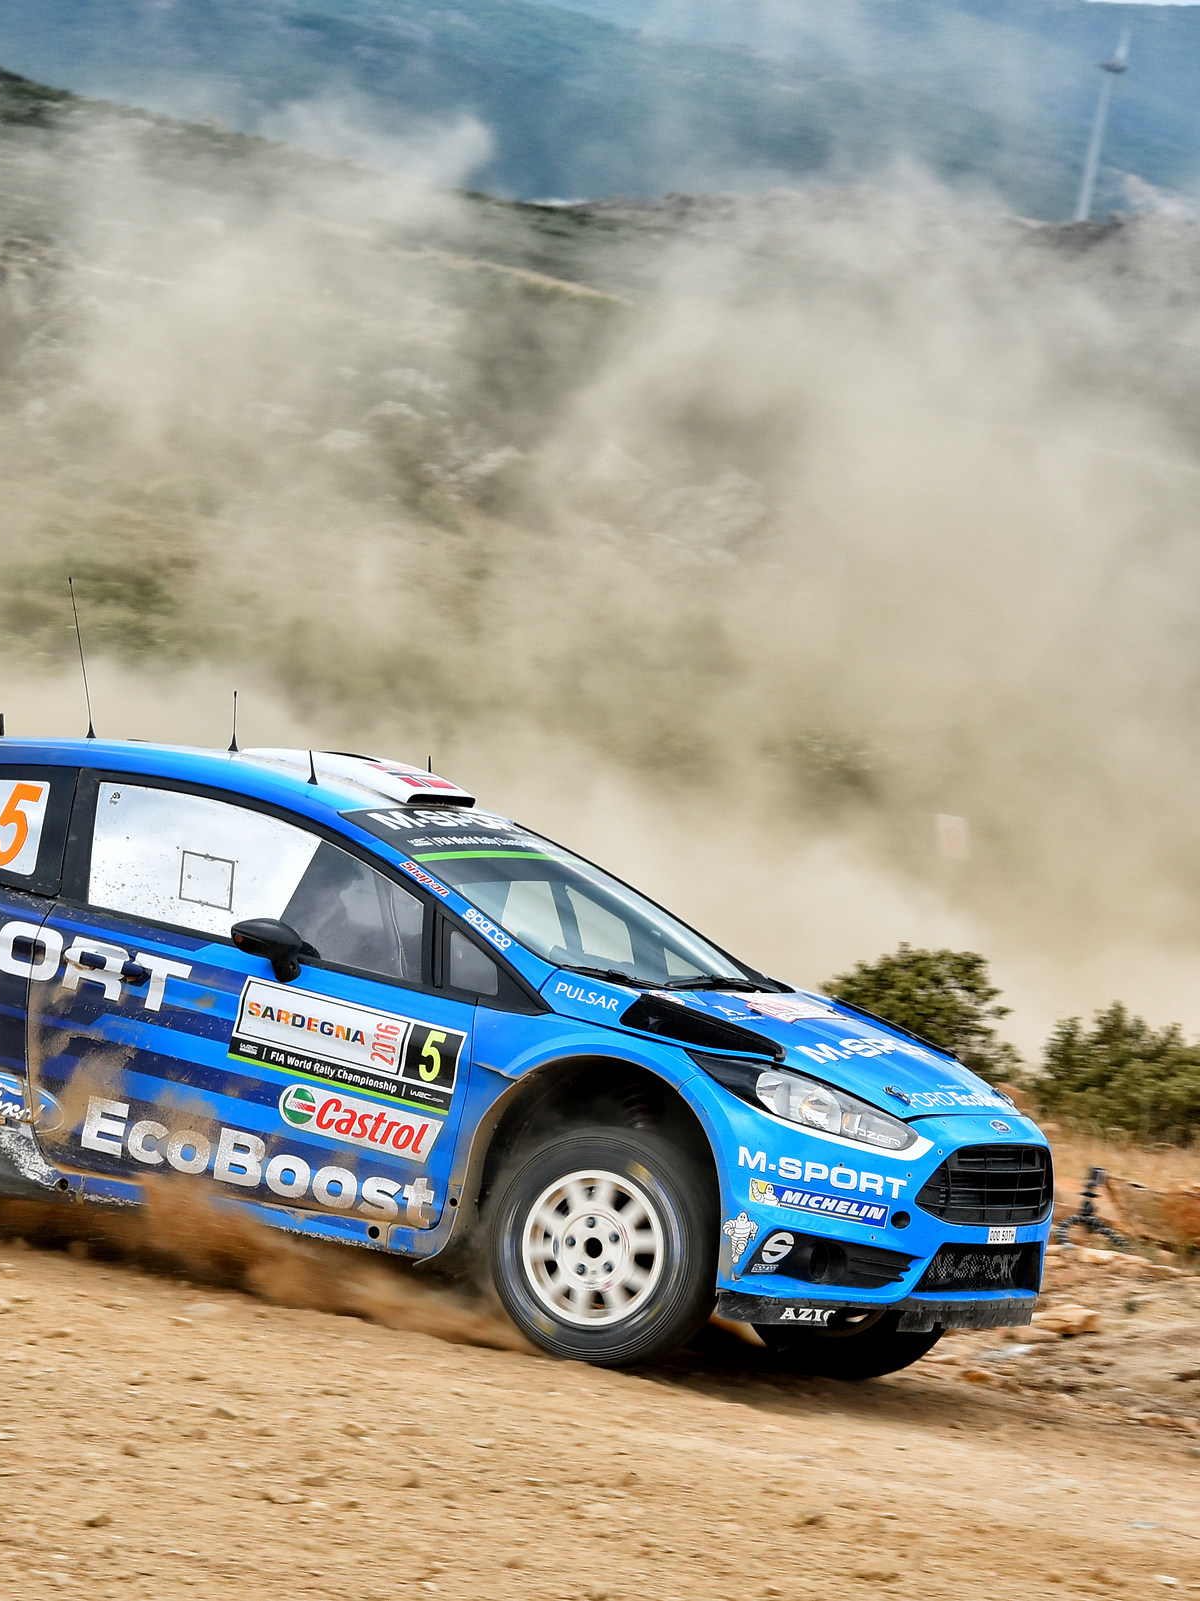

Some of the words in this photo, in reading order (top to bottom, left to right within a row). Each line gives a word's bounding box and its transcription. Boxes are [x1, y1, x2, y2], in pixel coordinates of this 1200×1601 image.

[465, 908, 512, 948] sparco
[554, 981, 619, 1012] PULSAR
[248, 1002, 365, 1045] SARDEGNA
[370, 1023, 400, 1066] 2016
[418, 1030, 447, 1082] 5
[270, 1051, 285, 1065] FIA
[287, 1054, 311, 1071] World
[313, 1063, 335, 1078] Rally
[337, 1068, 398, 1093] Championship
[316, 1098, 429, 1155] Castrol
[81, 1095, 435, 1228] EcoBoost
[738, 1145, 907, 1199] M-SPORT
[781, 1190, 886, 1220] MICHELIN
